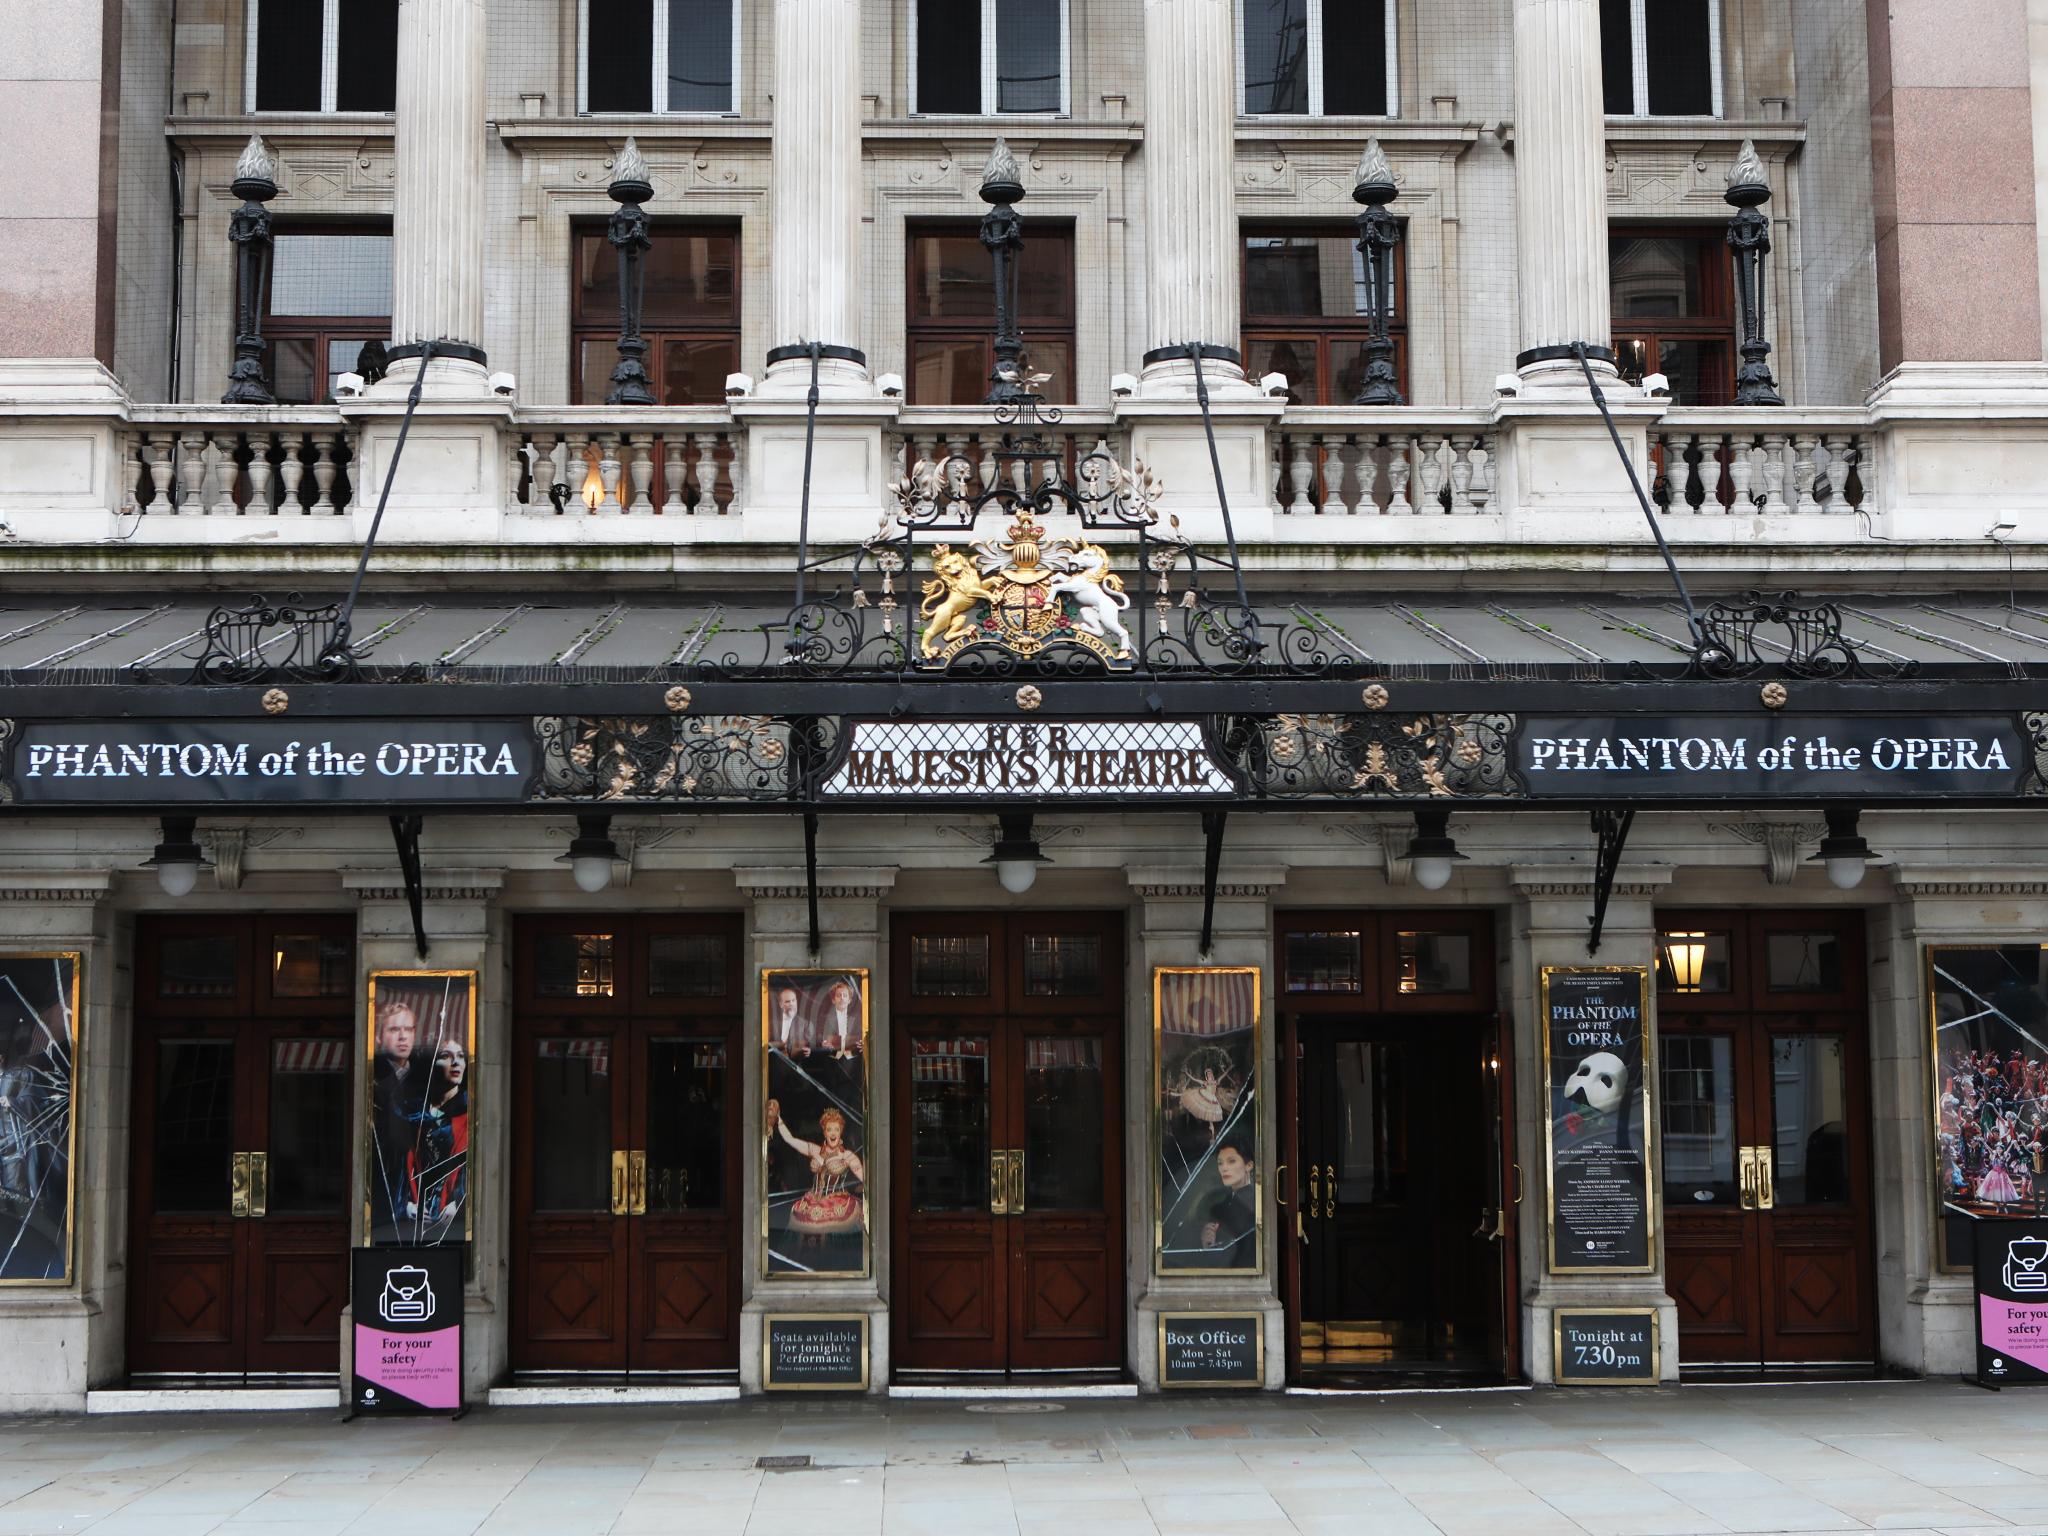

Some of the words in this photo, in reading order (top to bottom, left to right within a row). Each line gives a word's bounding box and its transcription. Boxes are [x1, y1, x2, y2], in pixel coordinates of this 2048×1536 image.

[1075, 632, 1111, 658] DROIT
[986, 726, 1069, 750] HER
[27, 743, 249, 777] PHANTOM
[259, 741, 301, 777] of
[307, 741, 366, 777] the
[376, 742, 519, 777] OPERA
[1530, 738, 1748, 771] PHANTOM
[1757, 736, 1797, 771] of
[1804, 736, 1861, 771] the
[1870, 738, 2011, 771] OPERA
[1049, 749, 1216, 786] THEATRE
[1584, 997, 1605, 1005] THE
[1552, 1006, 1637, 1019] PHANTOM
[1578, 1021, 1590, 1030] OF
[1592, 1021, 1612, 1030] THE
[1567, 1032, 1624, 1046] OPERA
[2007, 1308, 2027, 1319] For
[2007, 1322, 2042, 1337] safety
[773, 1332, 803, 1343] Seats
[806, 1331, 857, 1343] available
[1167, 1332, 1195, 1345] Box
[1200, 1331, 1247, 1345] Office
[1569, 1329, 1625, 1345] Tonight
[1630, 1331, 1644, 1342] at
[382, 1338, 402, 1349] For
[405, 1340, 433, 1352] your
[780, 1343, 797, 1353] for
[801, 1342, 851, 1355] tonight's
[382, 1352, 417, 1367] safety
[780, 1353, 852, 1363] Performance
[1181, 1349, 1204, 1358] Mon
[1216, 1348, 1231, 1358] Sat
[1171, 1360, 1196, 1369] 10am
